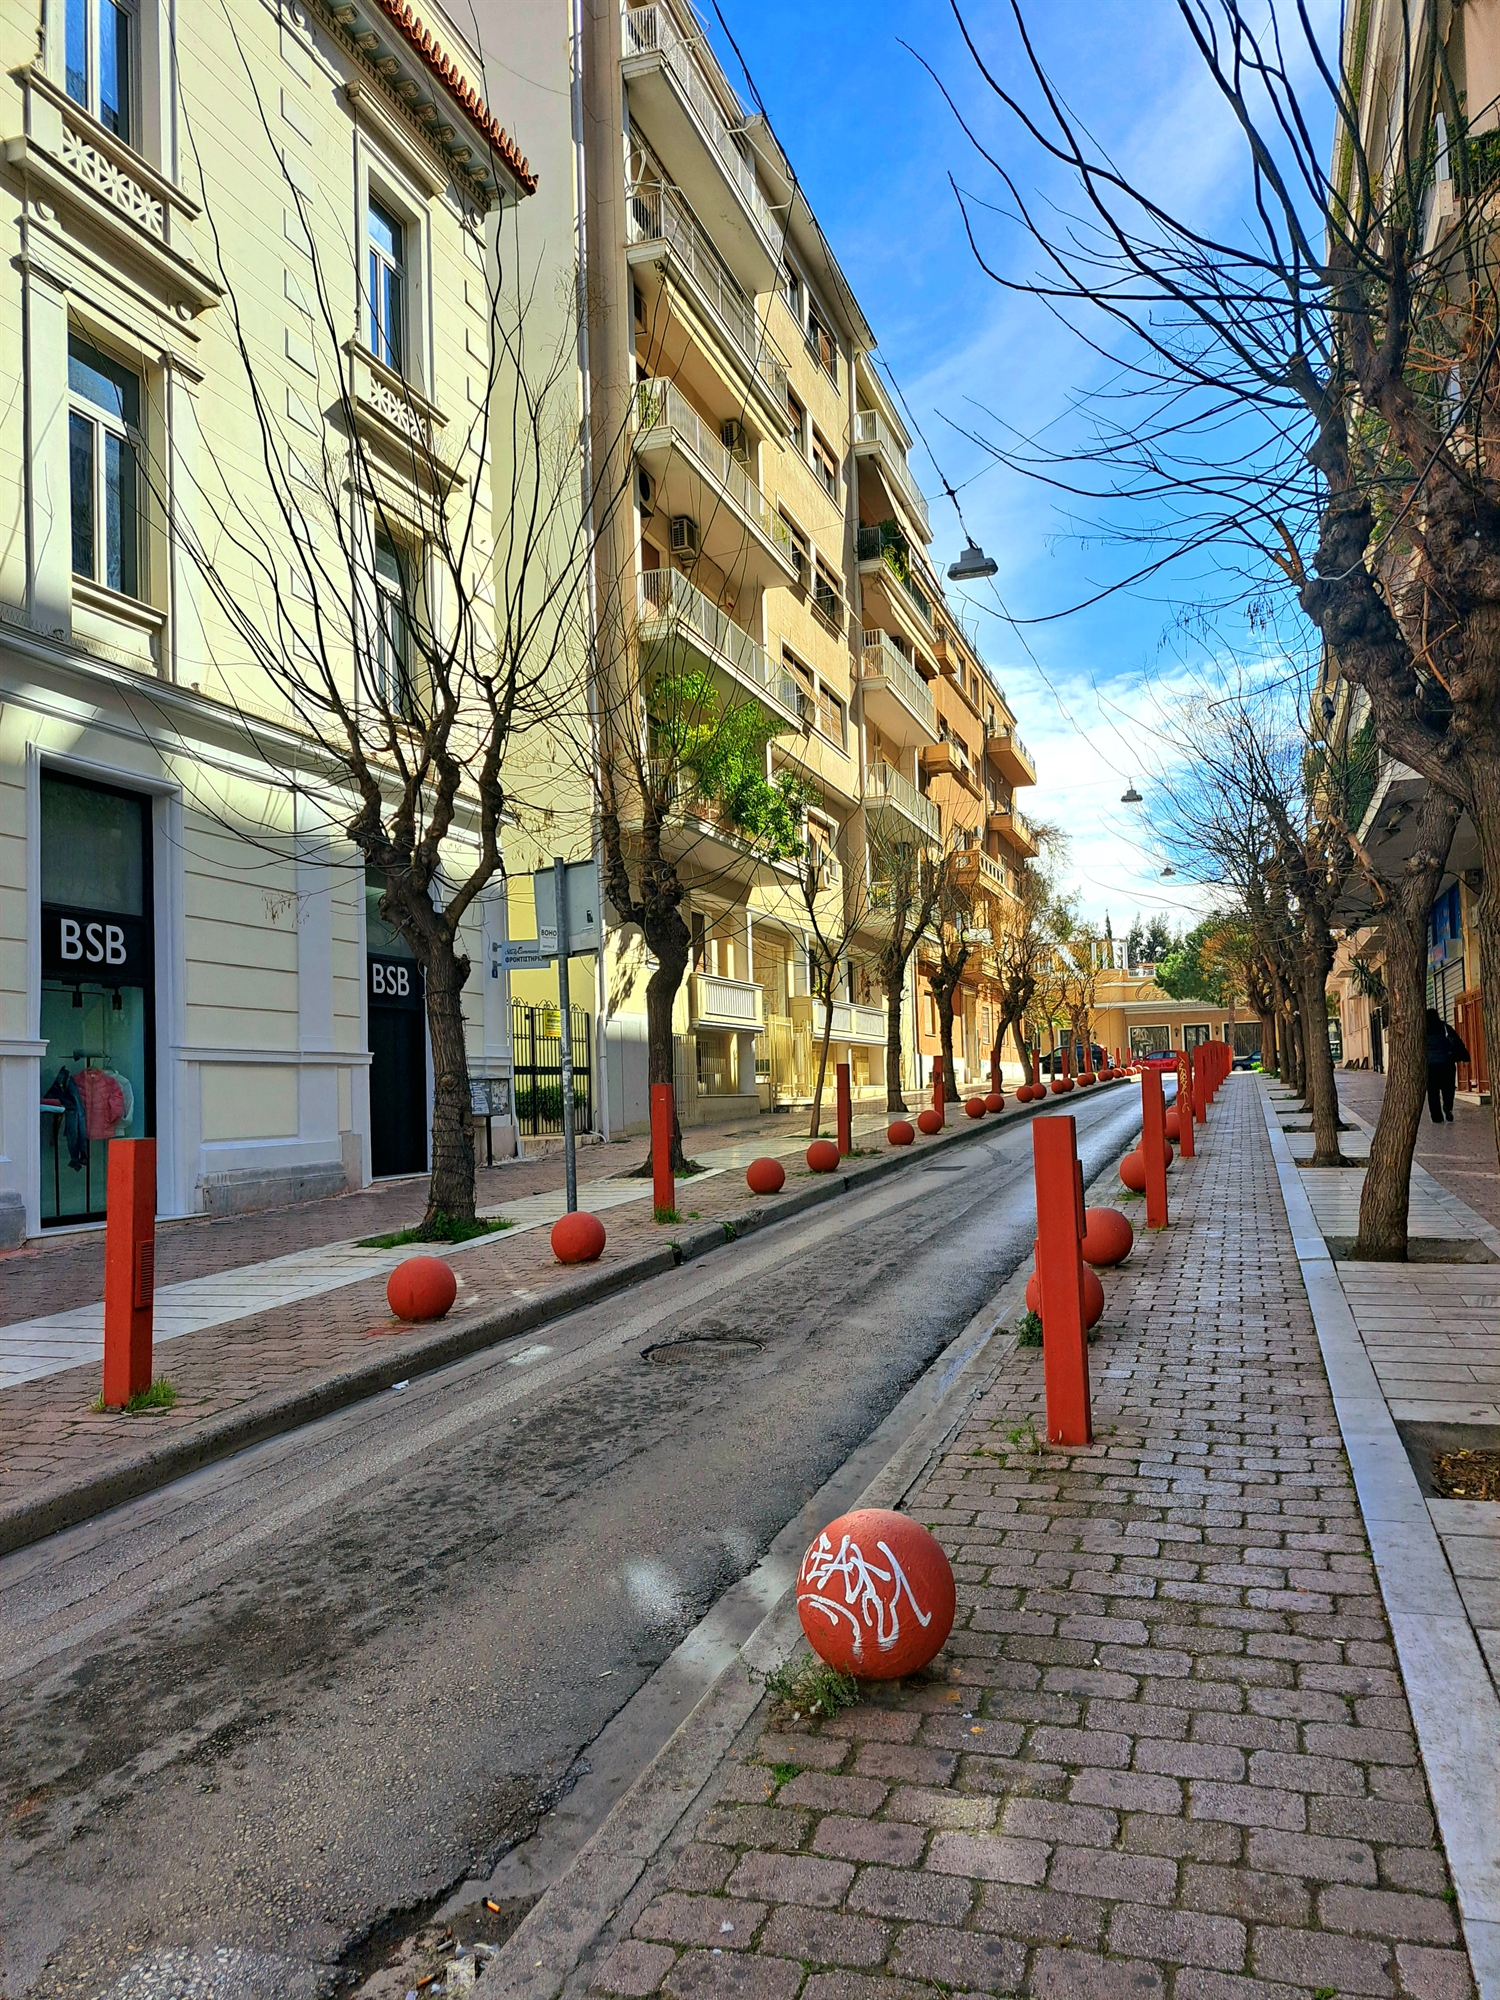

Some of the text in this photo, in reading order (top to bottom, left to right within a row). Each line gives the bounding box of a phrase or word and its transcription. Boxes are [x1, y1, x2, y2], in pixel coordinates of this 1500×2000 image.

[60, 918, 127, 965] BSB
[541, 929, 557, 937] BOHO
[372, 963, 410, 996] BSB
